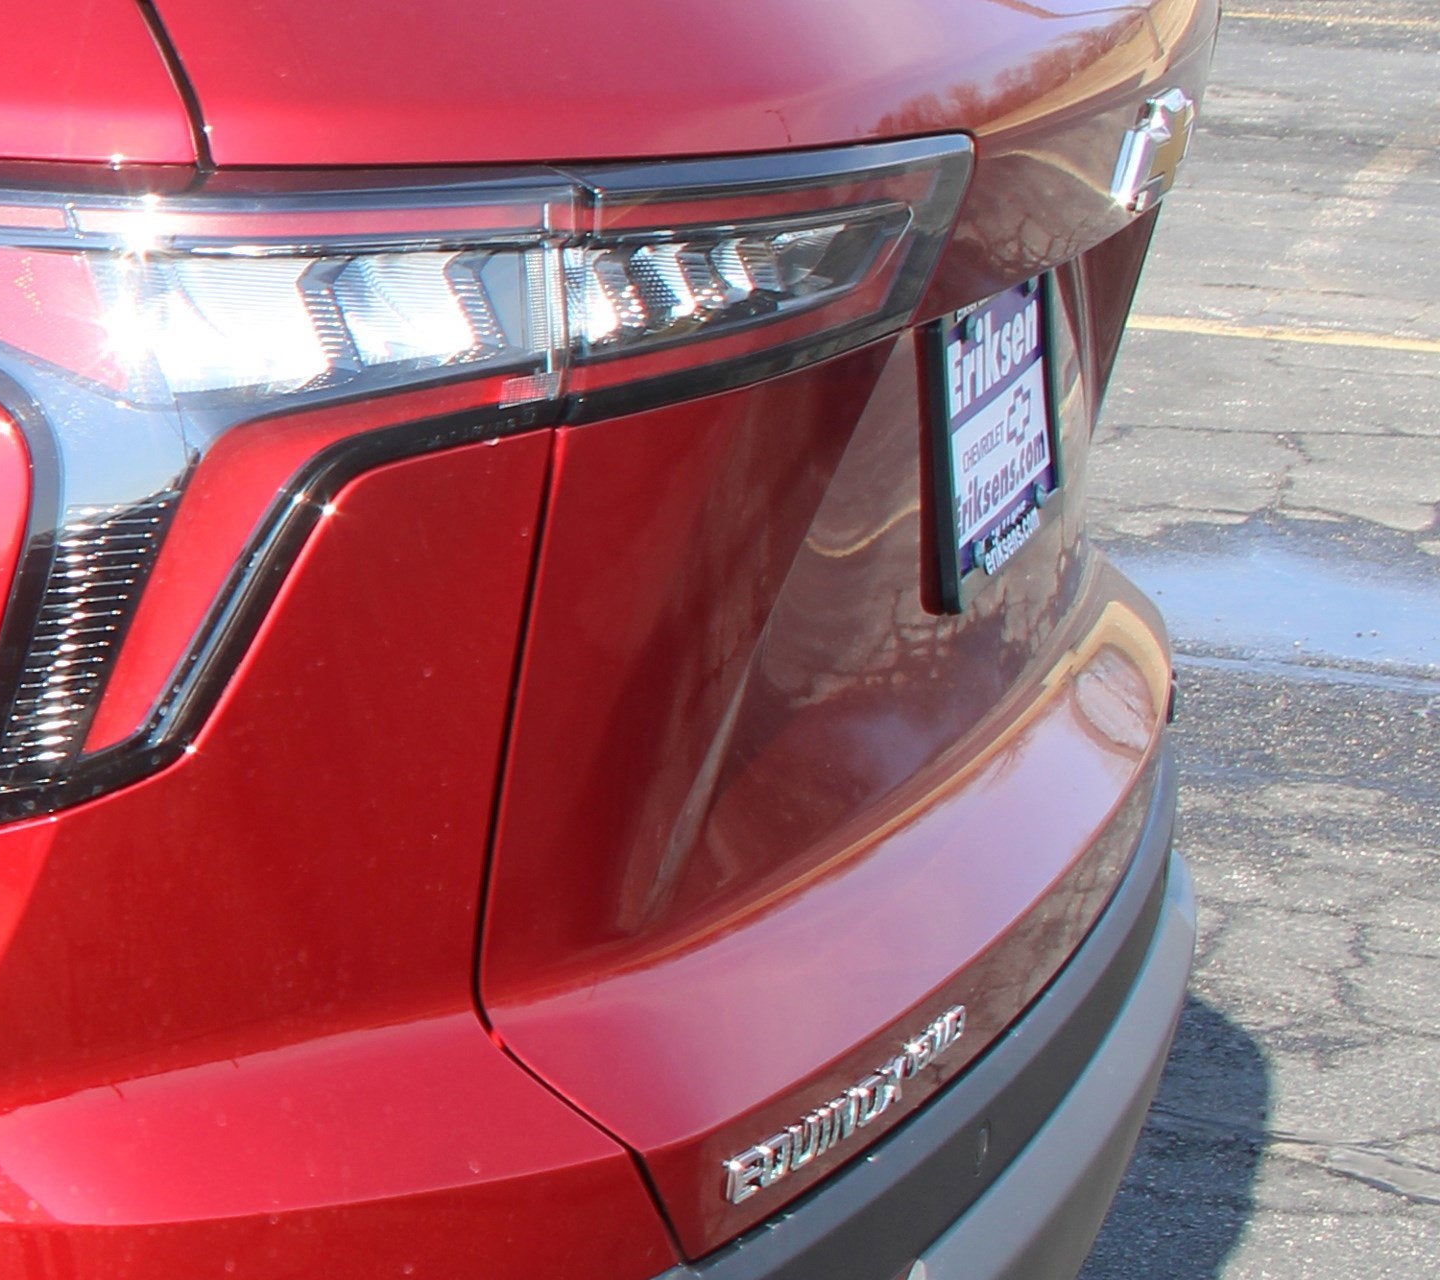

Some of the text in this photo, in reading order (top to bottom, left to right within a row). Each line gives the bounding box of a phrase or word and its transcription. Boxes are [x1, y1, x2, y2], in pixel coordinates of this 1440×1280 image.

[947, 299, 1038, 419] Eriksen
[962, 421, 1004, 474] CHEVROLET
[721, 1065, 905, 1204] EQUINOX
